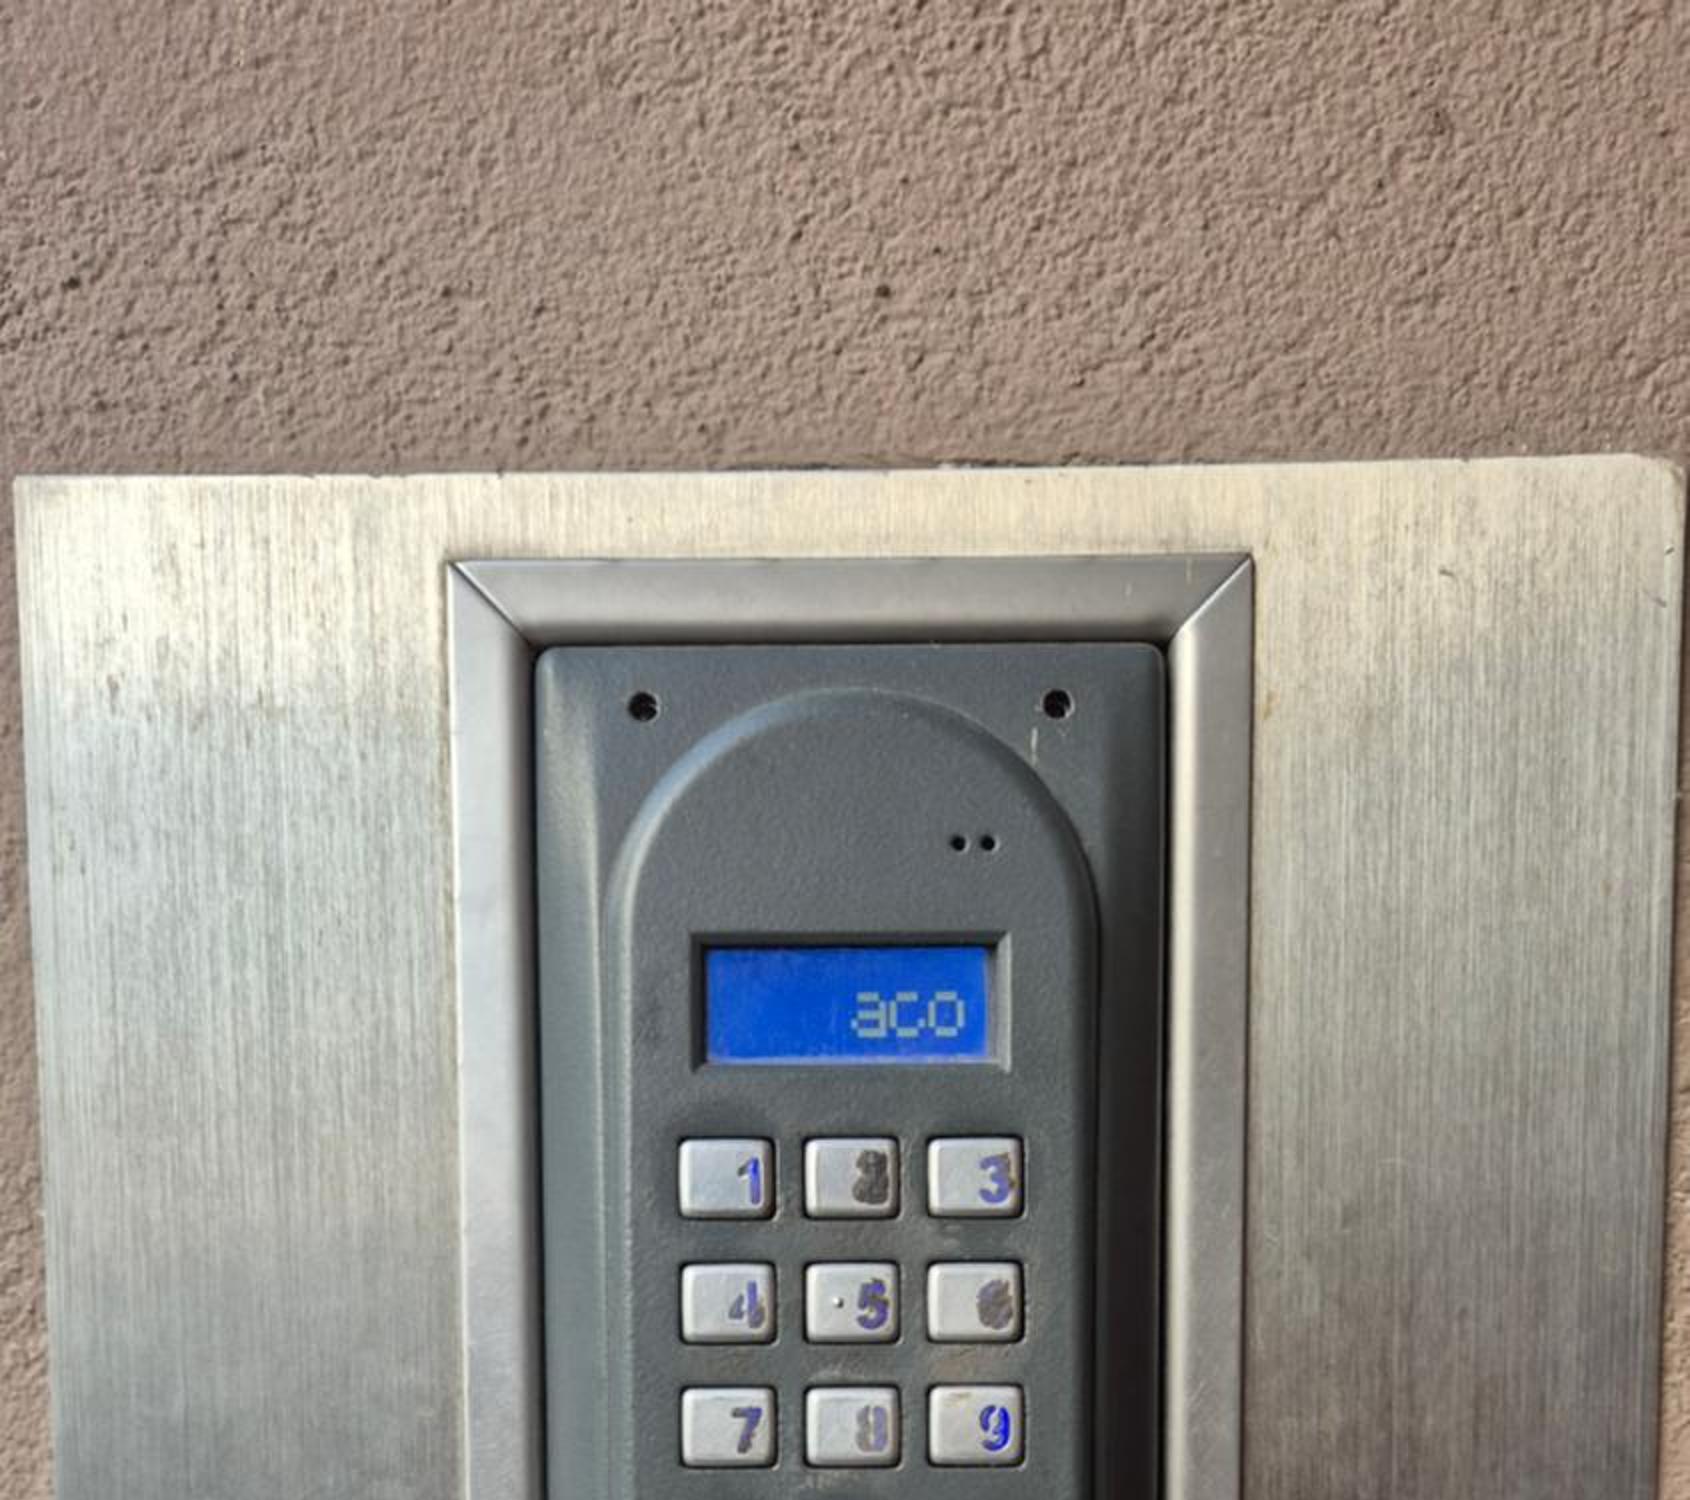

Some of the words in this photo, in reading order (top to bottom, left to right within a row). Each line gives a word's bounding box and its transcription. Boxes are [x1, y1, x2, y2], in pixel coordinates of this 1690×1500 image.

[850, 991, 965, 1038] aco
[737, 1157, 761, 1205] 1
[978, 1153, 1014, 1206] 3
[728, 1280, 765, 1329] 4
[856, 1277, 889, 1330] 5
[731, 1406, 763, 1454] 7
[855, 1404, 889, 1453] 8
[979, 1404, 1011, 1452] 9
